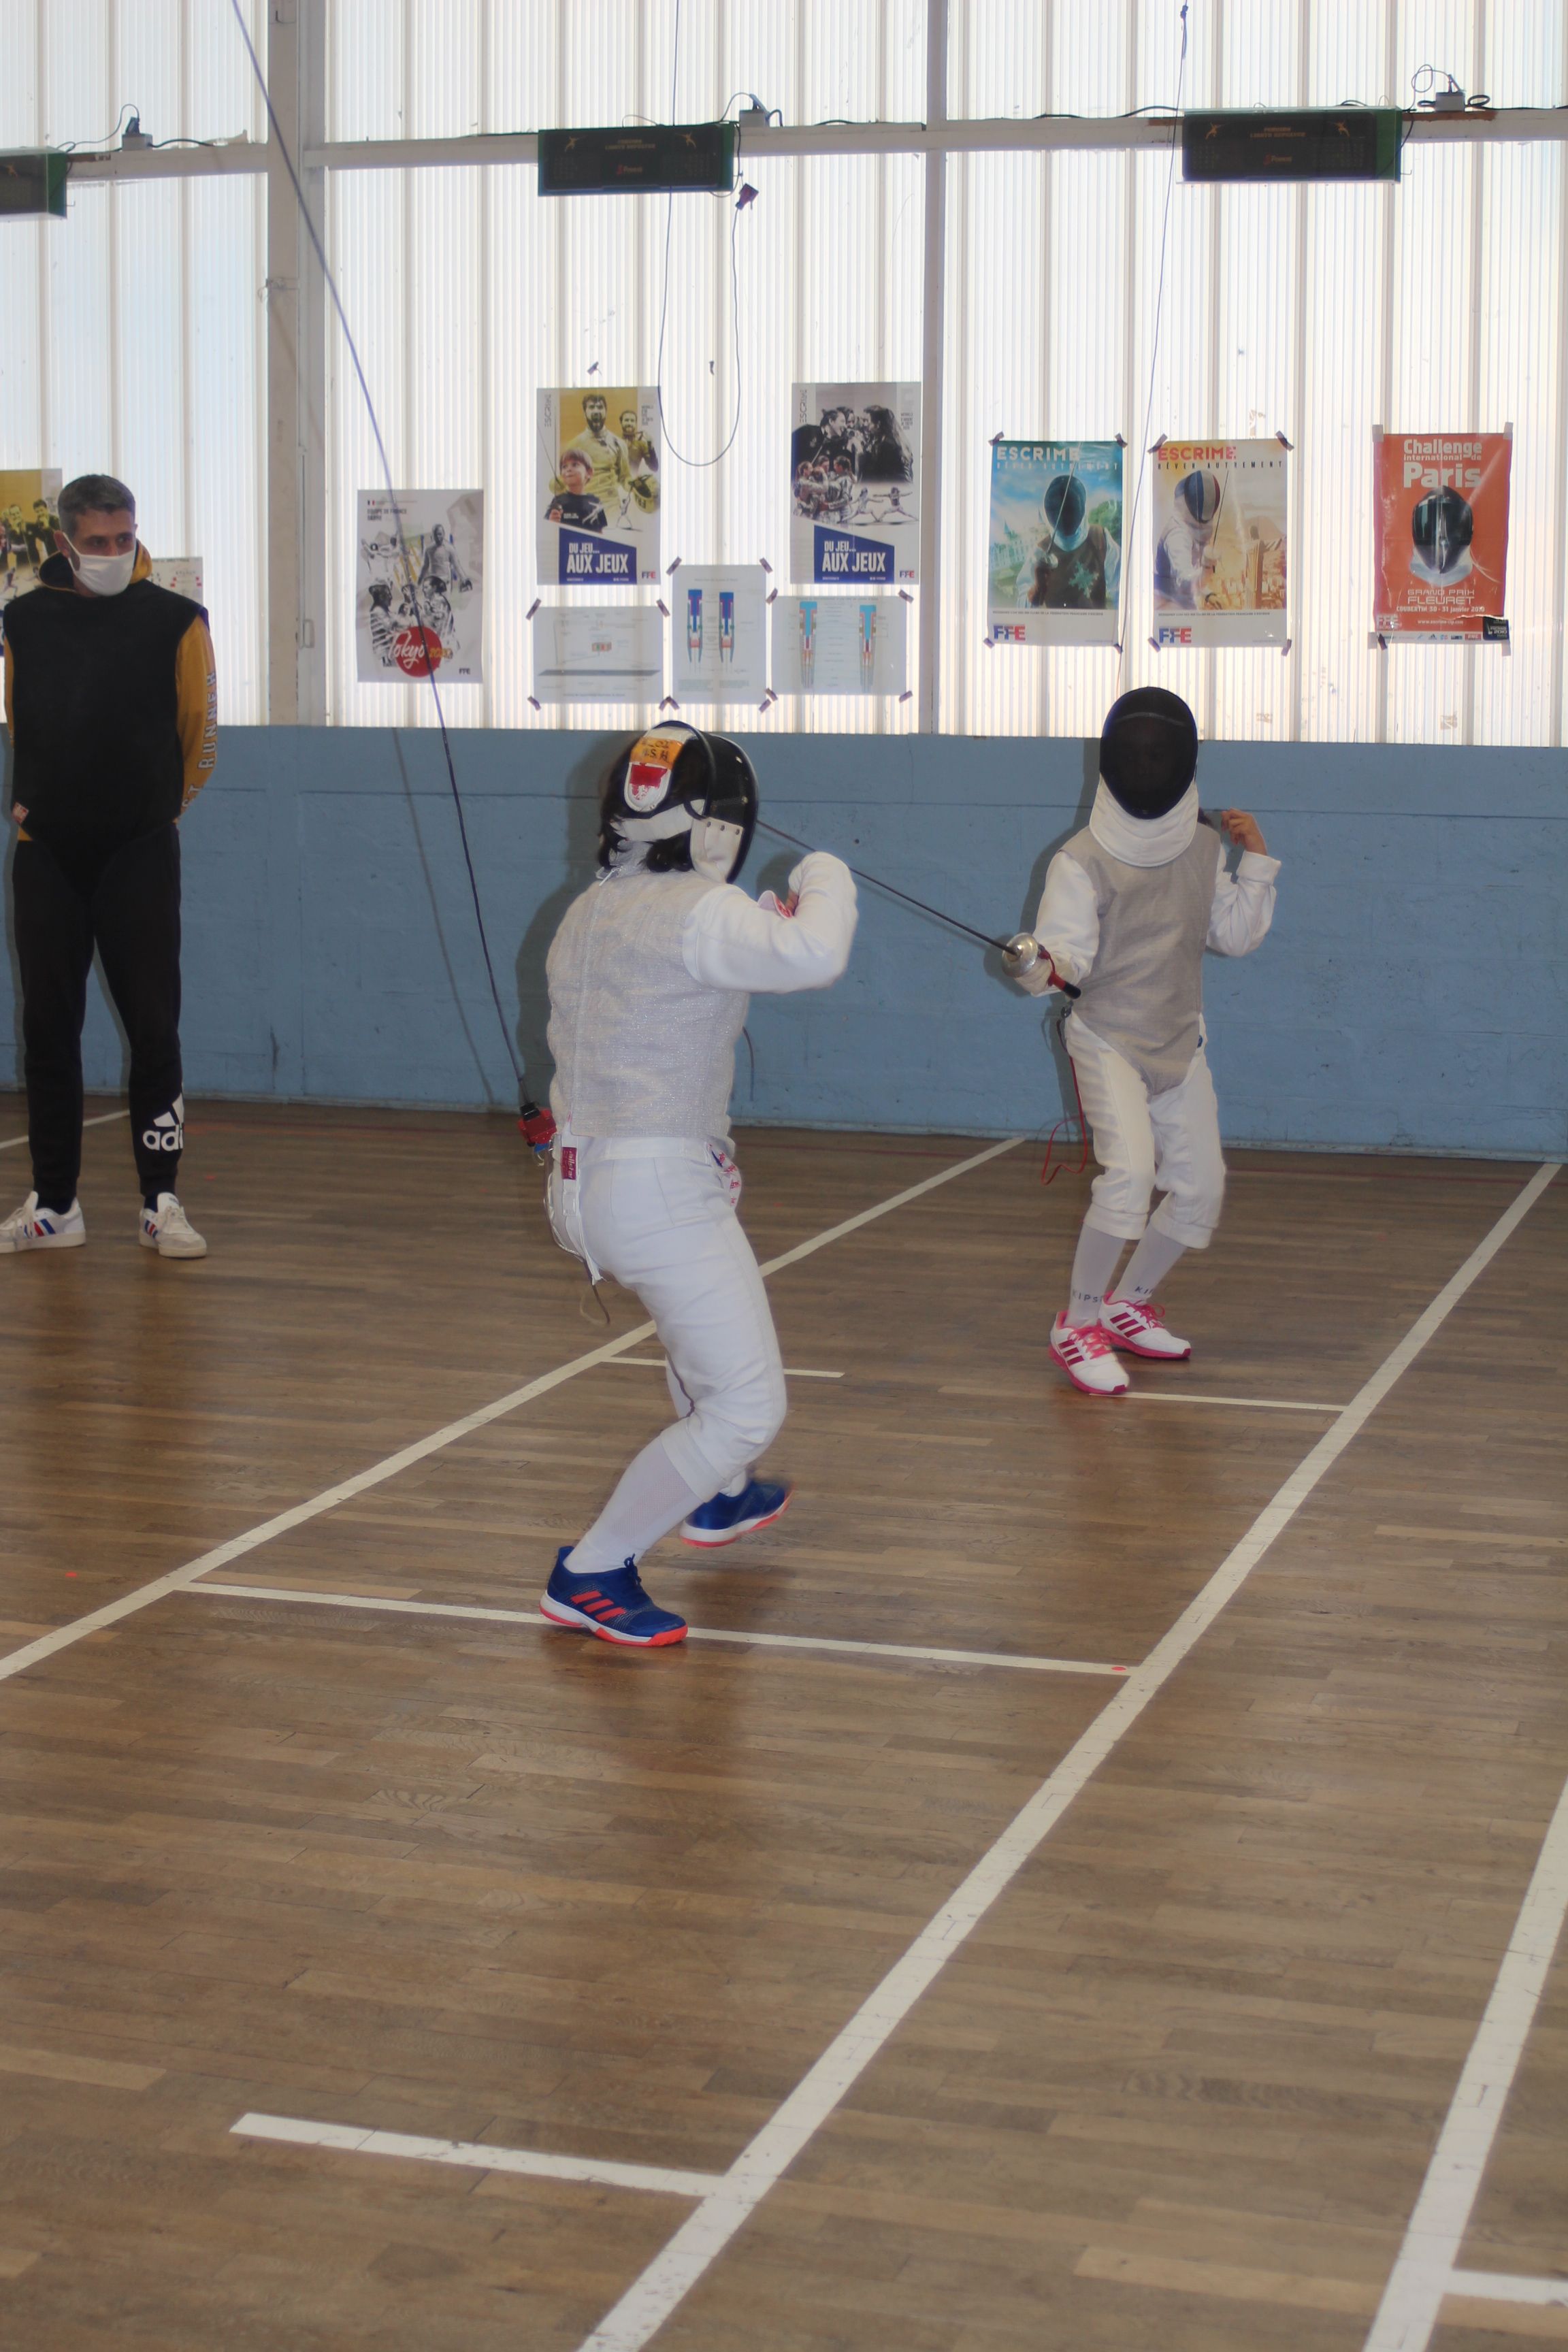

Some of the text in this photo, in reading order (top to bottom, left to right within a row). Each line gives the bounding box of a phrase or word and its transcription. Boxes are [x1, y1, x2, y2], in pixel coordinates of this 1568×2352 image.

[996, 446, 1080, 461] ESCRIME
[1158, 446, 1237, 461] ESCRIME
[1403, 439, 1482, 458] Challenge
[1207, 461, 1283, 470] AUTREMENT
[1403, 462, 1482, 488] Paris
[569, 542, 600, 554] DU JEU...
[824, 541, 856, 552] DU JEU...
[566, 554, 629, 573] AUX JEUX
[822, 553, 886, 572] AUX JEUX
[1407, 596, 1475, 605] FLEURET
[1450, 605, 1469, 614] janvier
[994, 625, 1026, 640] FFE
[1159, 627, 1192, 644] FFE
[389, 630, 425, 669] Tokyo
[198, 672, 217, 769] RUNNER
[143, 1123, 184, 1152] adi
[1072, 1288, 1103, 1303] KIPS
